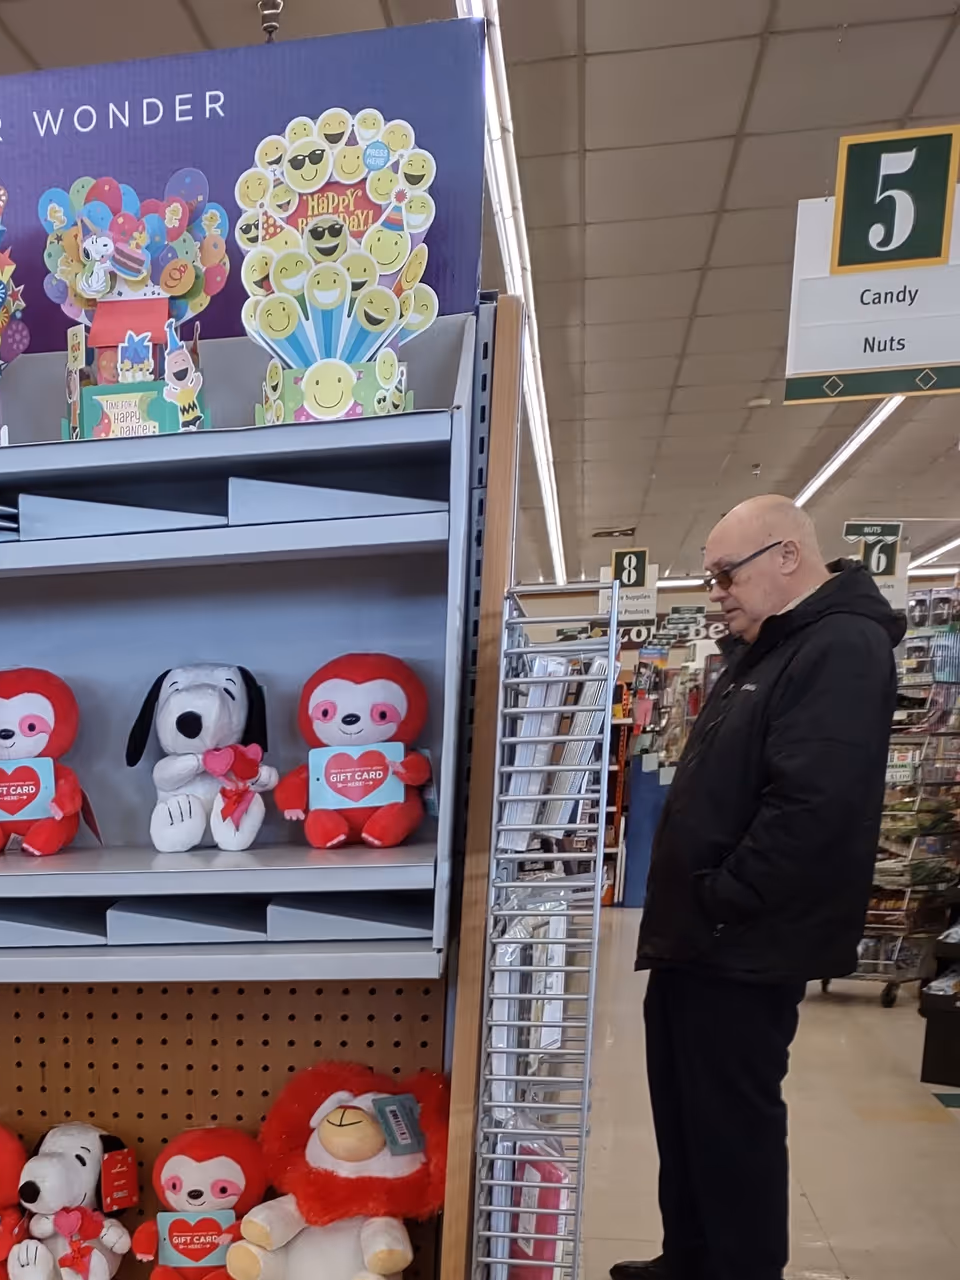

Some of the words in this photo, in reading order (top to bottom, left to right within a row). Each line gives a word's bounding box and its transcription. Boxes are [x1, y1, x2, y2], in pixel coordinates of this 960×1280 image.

[33, 90, 226, 138] WONDER
[366, 149, 387, 157] PRESS
[366, 157, 385, 166] HERE
[868, 147, 918, 252] 5
[859, 285, 919, 306] Candy
[863, 336, 906, 353] Nuts
[871, 541, 887, 573] 6
[622, 554, 638, 585] 8
[330, 772, 352, 782] GIFT
[355, 771, 383, 780] CARD
[10, 785, 36, 794] CARD
[173, 1236, 191, 1244] GIFT
[193, 1235, 218, 1244] CARD
